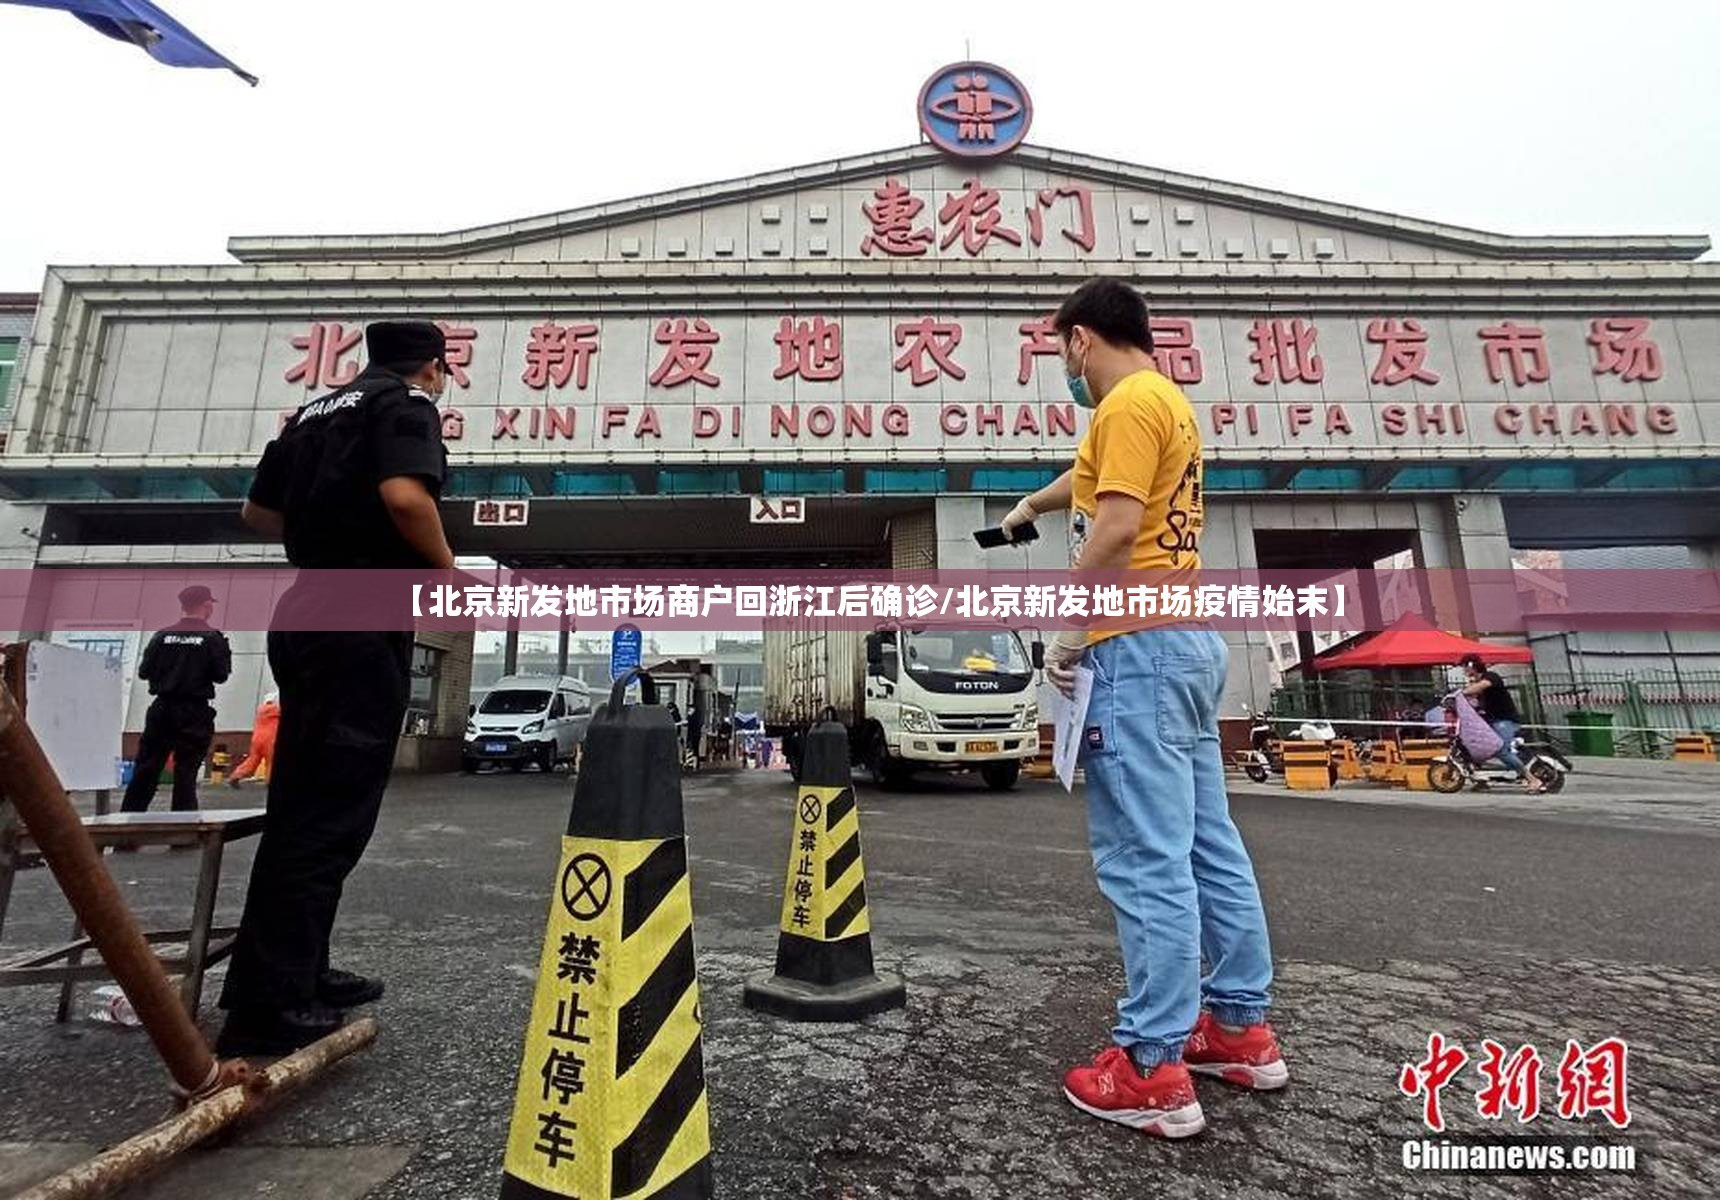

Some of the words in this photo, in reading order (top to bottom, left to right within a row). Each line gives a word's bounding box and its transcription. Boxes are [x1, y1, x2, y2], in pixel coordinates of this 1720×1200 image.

[860, 177, 1096, 256] 惠农门
[493, 407, 576, 440] XIN
[602, 405, 662, 438] FA
[695, 405, 741, 438] DI
[771, 404, 910, 438] NONG
[940, 404, 1076, 437] CHAN
[1213, 404, 1257, 434] PI
[1289, 404, 1352, 434] FA
[1382, 404, 1465, 434] SHI
[1494, 403, 1679, 434] CHANG
[477, 502, 525, 523] 出口
[756, 500, 800, 520] 入口
[955, 681, 999, 690] FOTON
[792, 829, 817, 929] 禁止停车
[533, 931, 601, 1168] 禁止停车
